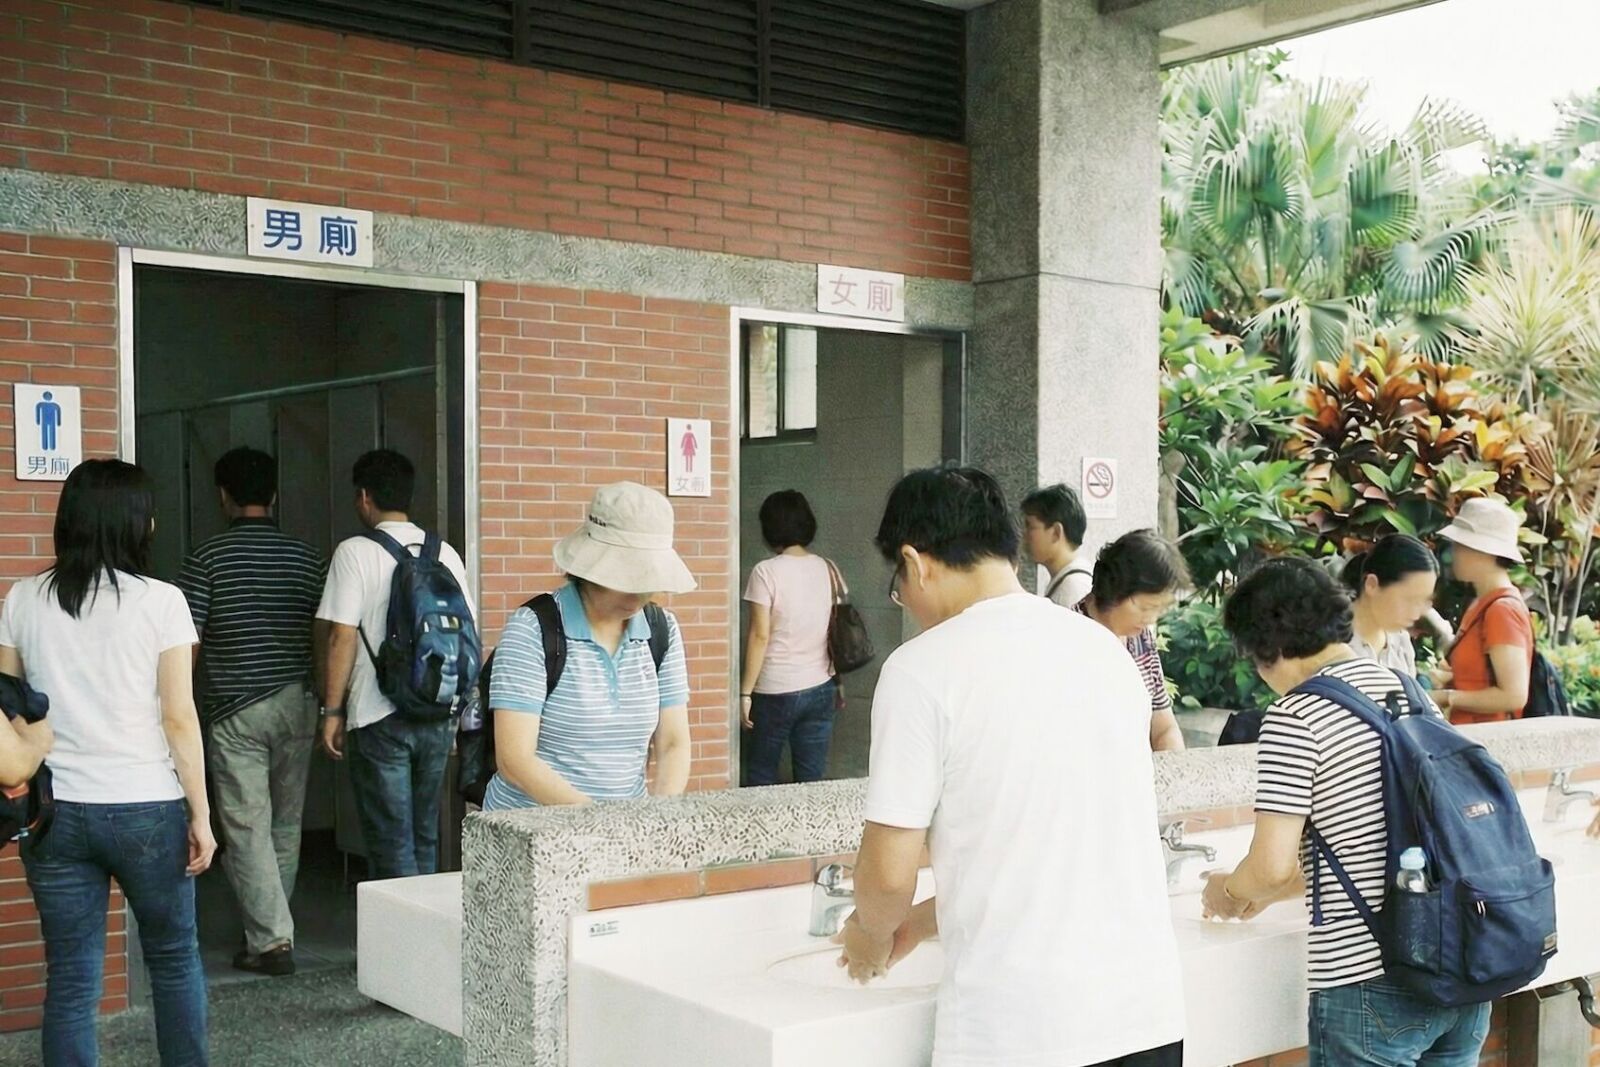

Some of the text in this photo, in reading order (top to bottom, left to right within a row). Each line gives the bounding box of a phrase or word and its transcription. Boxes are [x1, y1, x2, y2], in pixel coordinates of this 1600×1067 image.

[263, 209, 358, 257] 男廁
[828, 273, 894, 312] 女廁
[27, 456, 70, 475] 男廁
